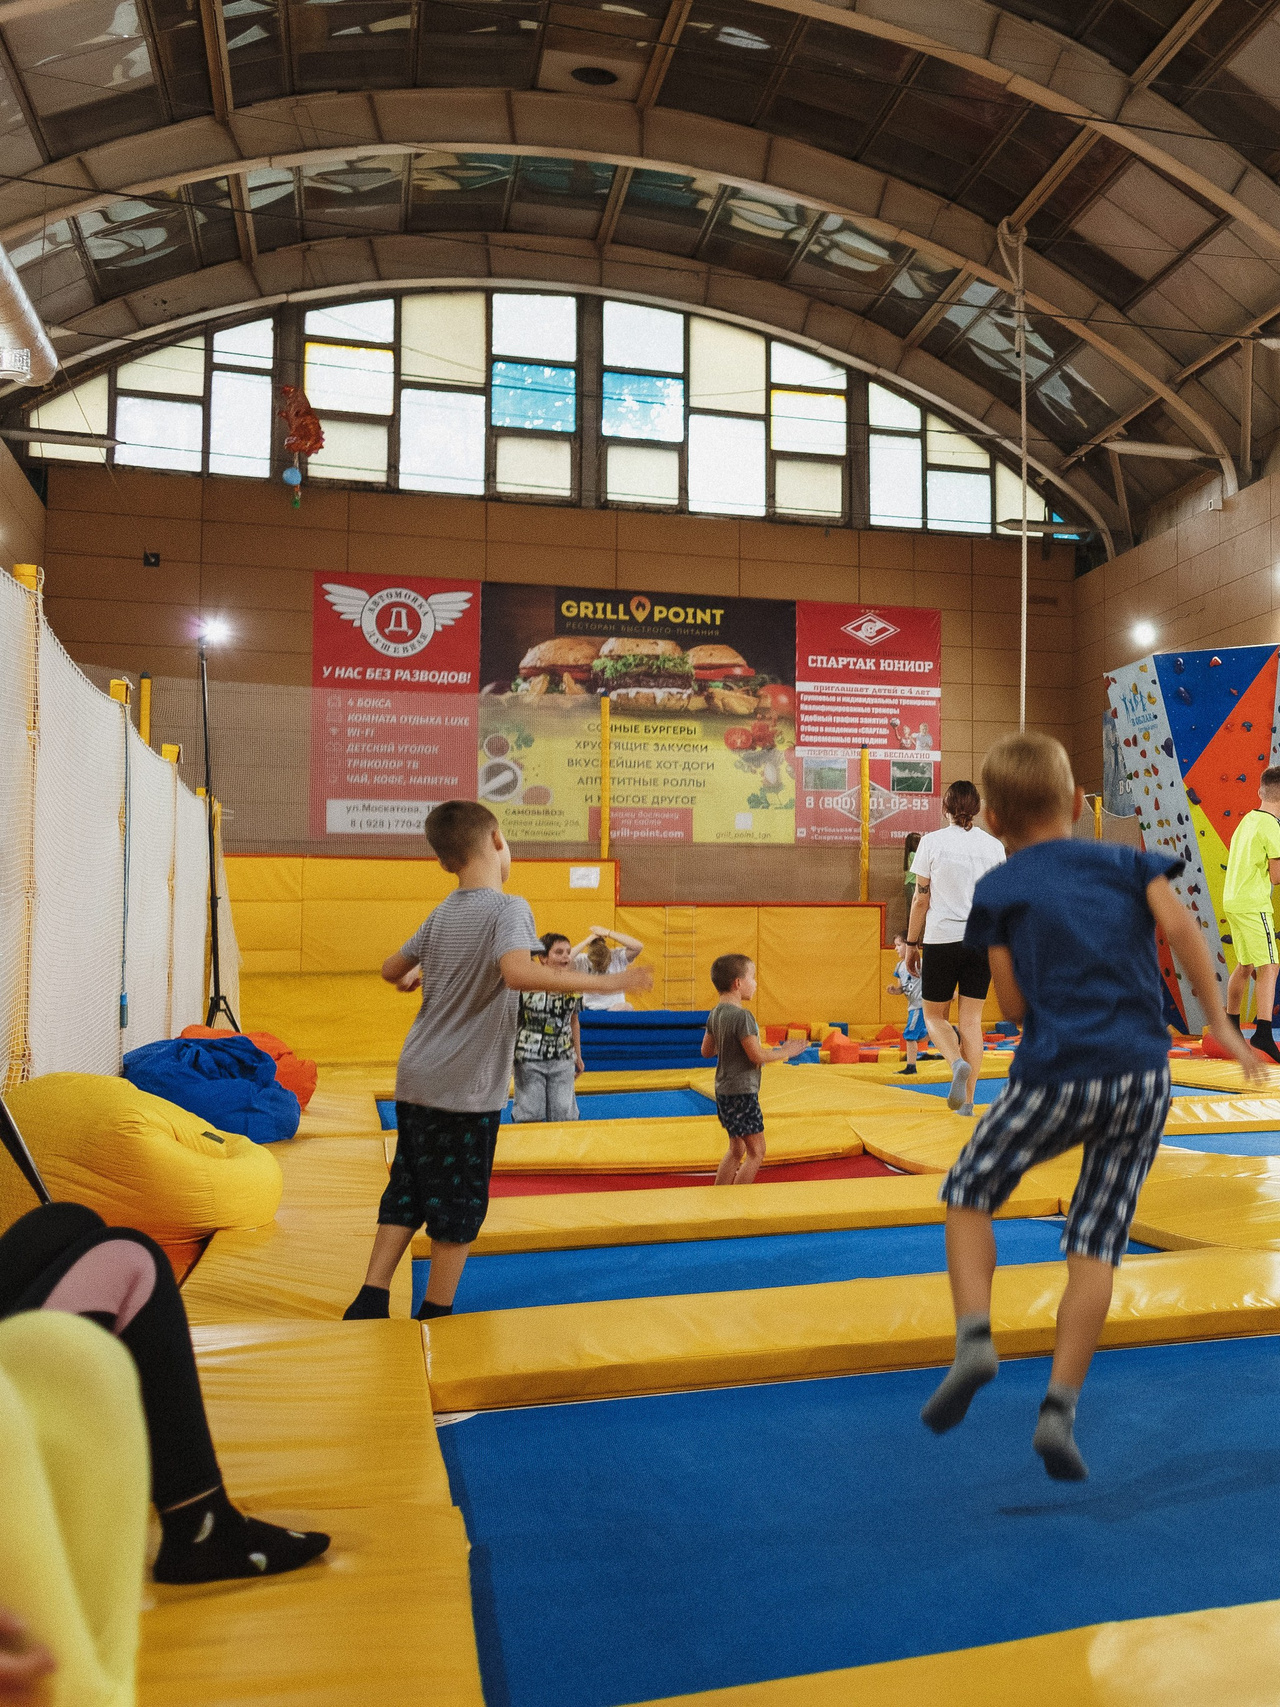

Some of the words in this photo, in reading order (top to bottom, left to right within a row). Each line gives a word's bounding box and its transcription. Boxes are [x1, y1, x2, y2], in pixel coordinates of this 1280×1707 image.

[561, 600, 630, 621] GRILL
[654, 606, 725, 626] POINT
[384, 606, 413, 636] Д
[808, 656, 876, 670] СПАРТАК
[880, 659, 934, 673] ЮНИОР
[322, 666, 332, 678] У
[334, 667, 363, 680] НАС
[366, 668, 391, 680] БЕЗ
[394, 669, 471, 685] РАЗВОДОВ!
[356, 698, 392, 708] БОКСА
[644, 724, 697, 735] БУРГЕРЫ
[653, 742, 708, 752] ЗАКУСКИ
[884, 751, 930, 760] БЕСПЛАТНО
[663, 778, 706, 788] РОЛЛЫ
[584, 795, 593, 803] И
[651, 796, 697, 806] ДРУГОЕ
[806, 796, 814, 808] 8
